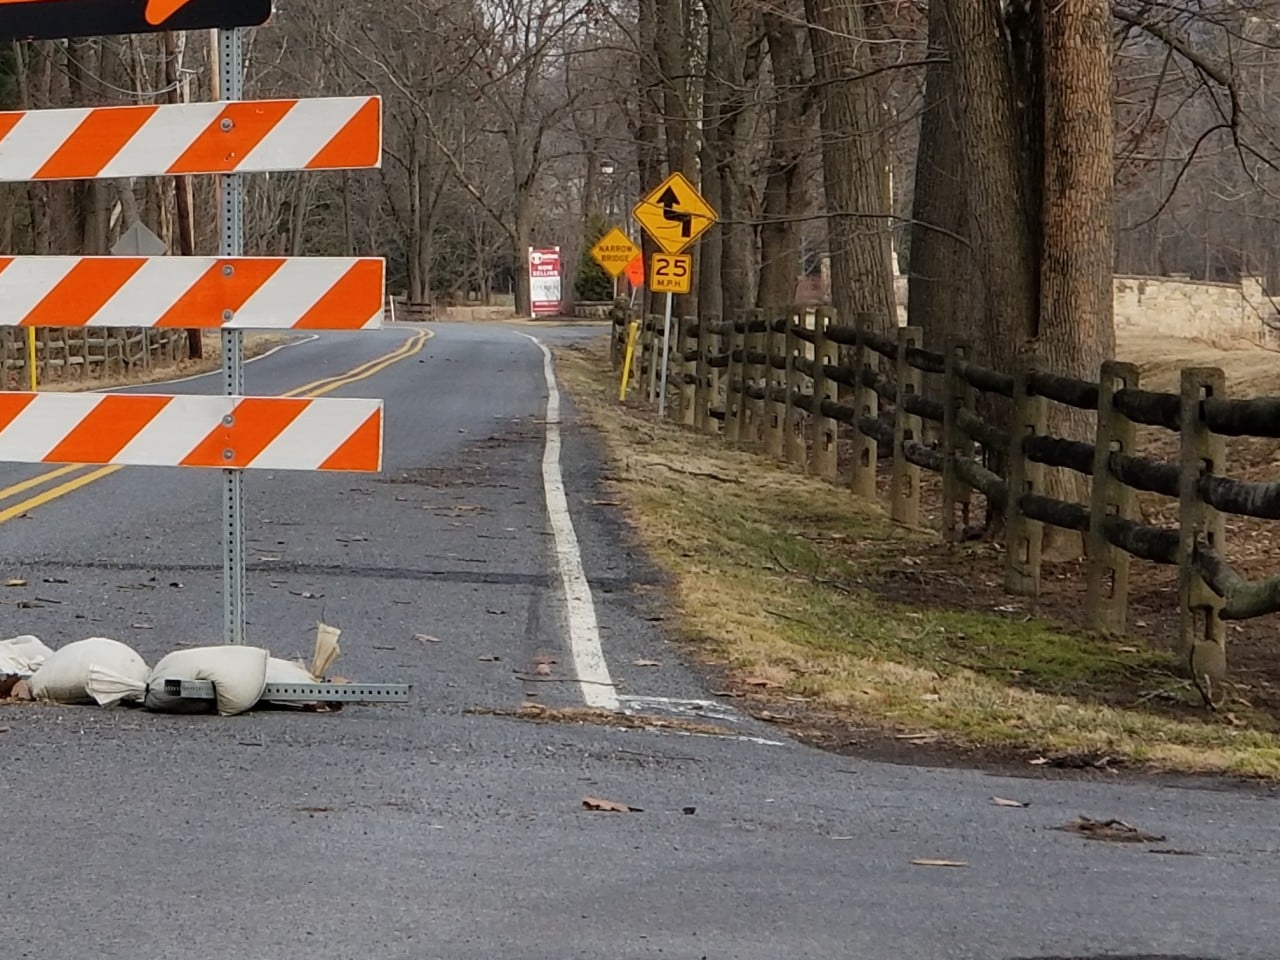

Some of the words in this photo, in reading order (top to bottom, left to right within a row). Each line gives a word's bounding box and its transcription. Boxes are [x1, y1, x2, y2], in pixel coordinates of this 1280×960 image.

[598, 245, 633, 253] NARROW
[601, 254, 630, 263] BRIDGE
[655, 258, 688, 277] 25
